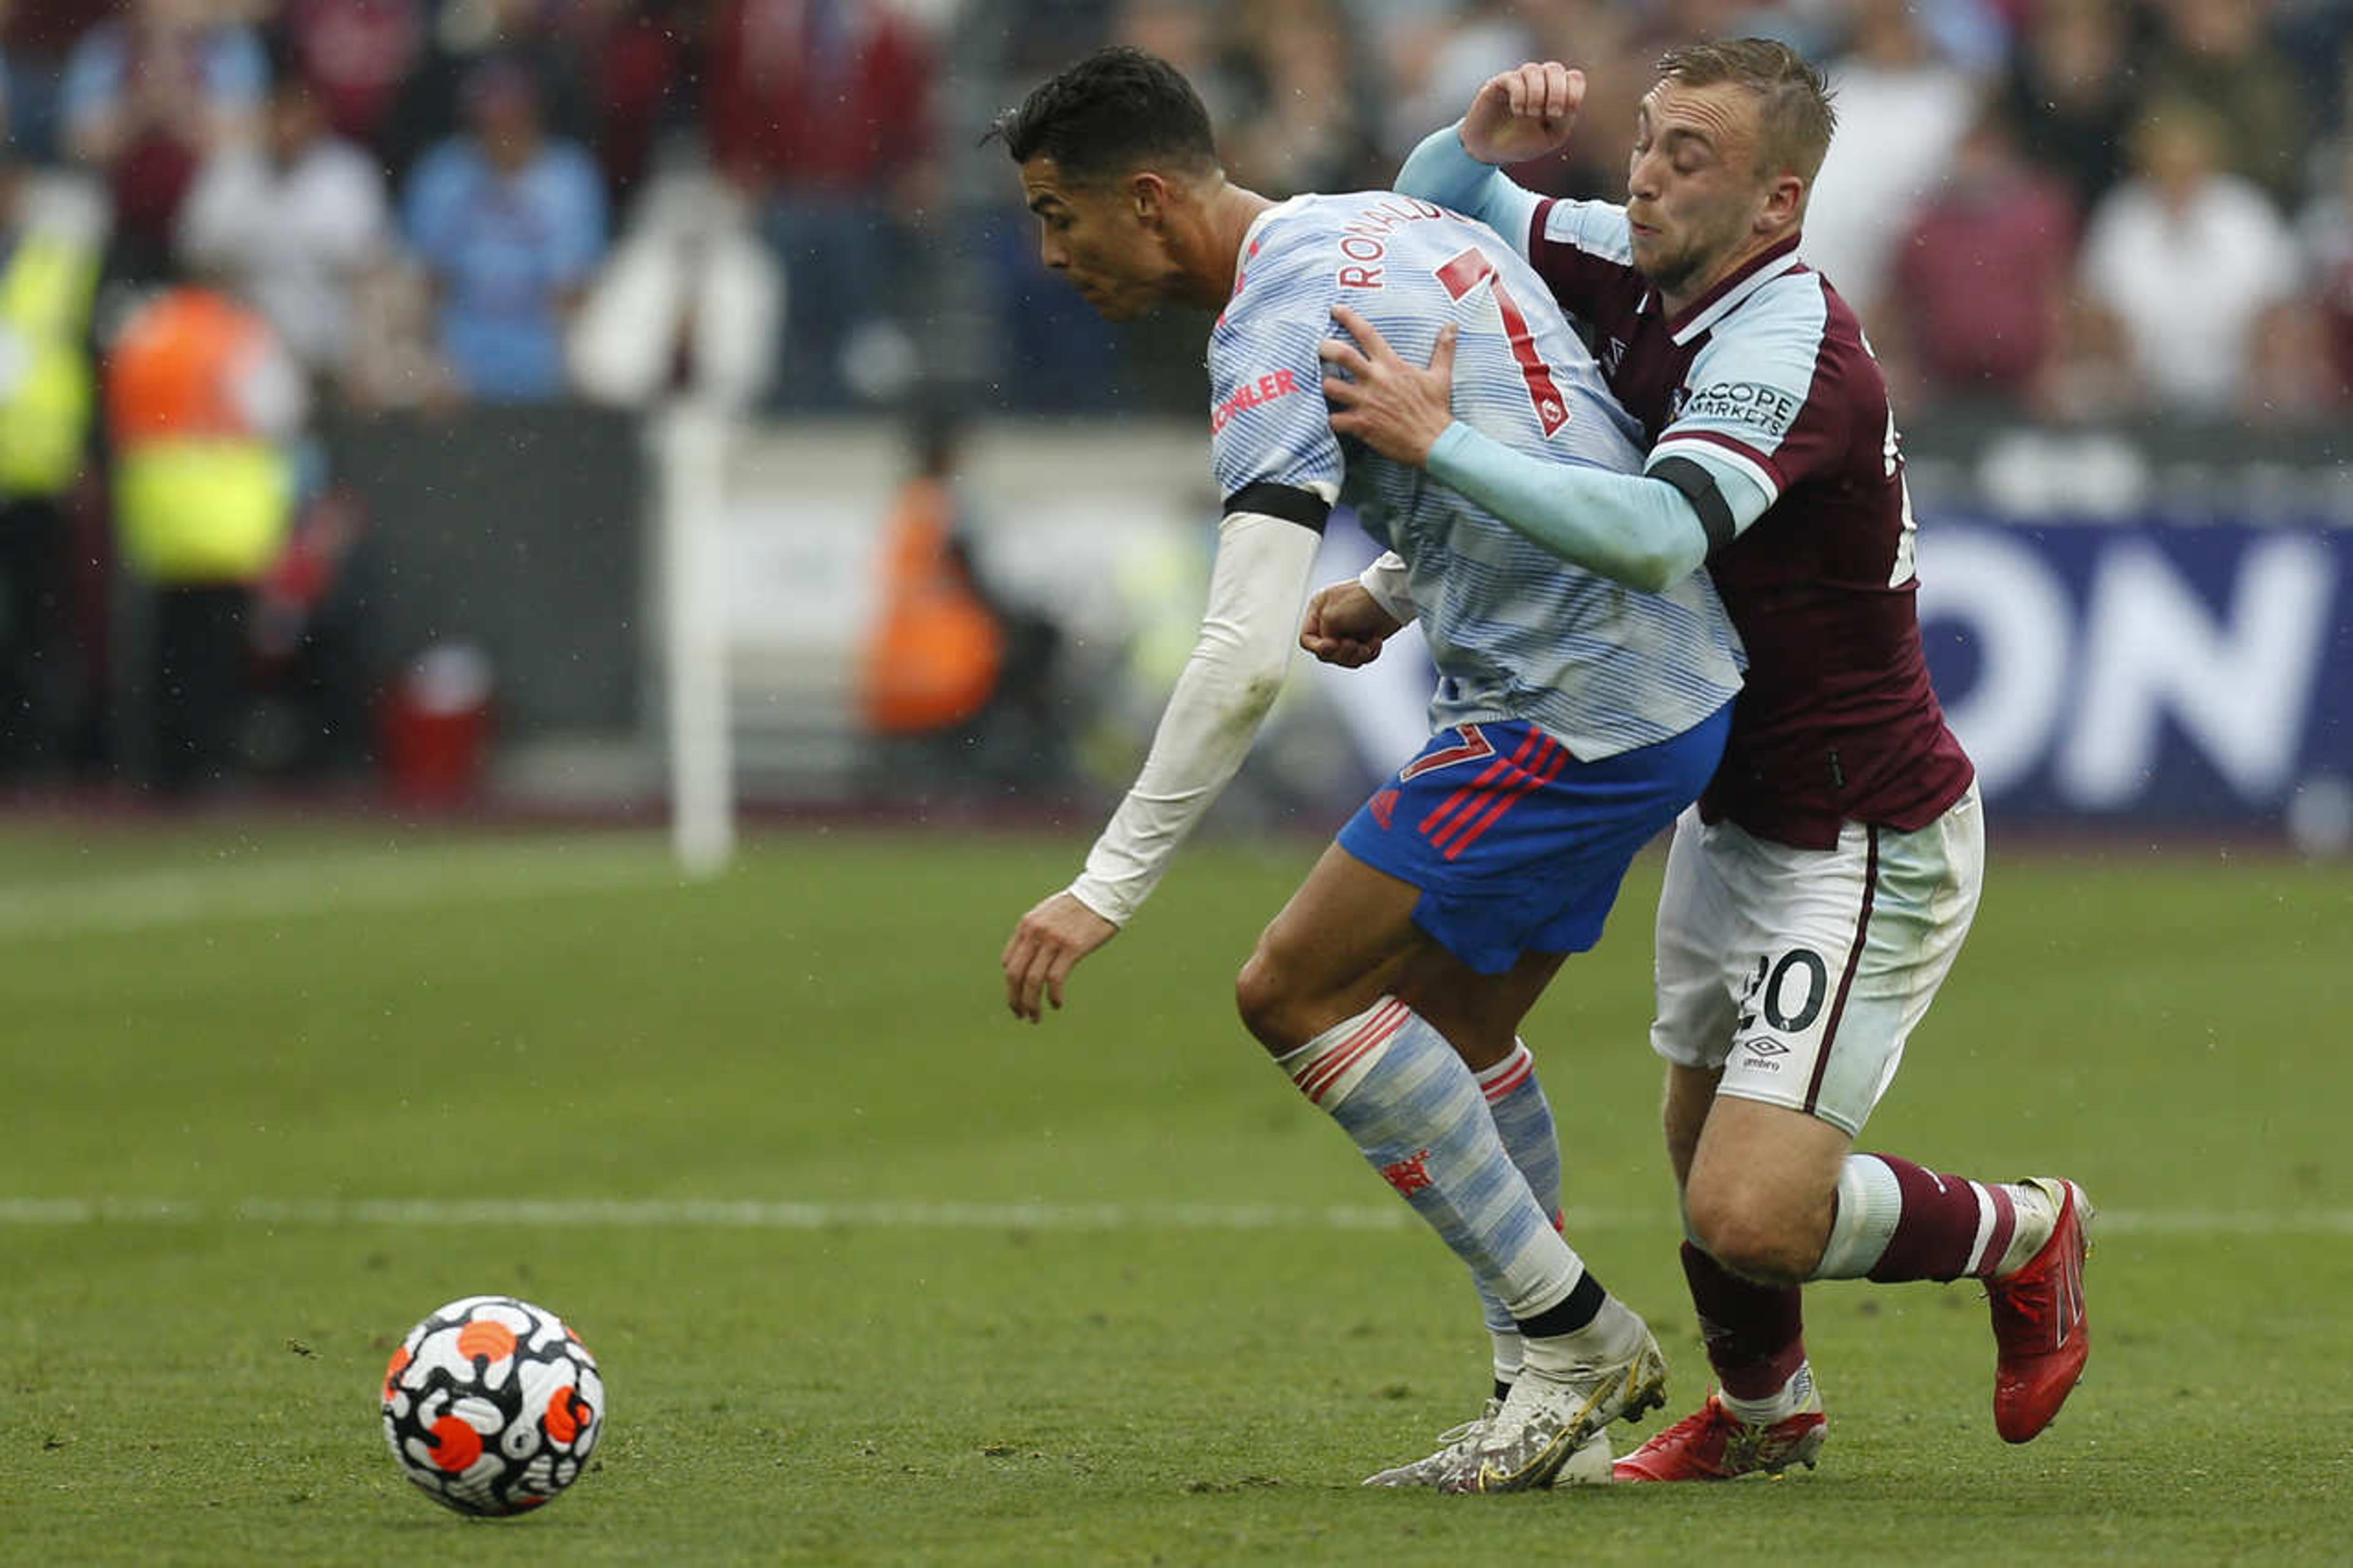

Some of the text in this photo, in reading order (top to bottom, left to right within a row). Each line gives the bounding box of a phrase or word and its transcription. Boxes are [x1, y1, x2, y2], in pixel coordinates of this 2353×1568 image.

[1434, 247, 1571, 440] 7
[1210, 368, 1300, 436] OHLER
[1689, 400, 1782, 436] MARKETS
[1400, 722, 1495, 782] 7
